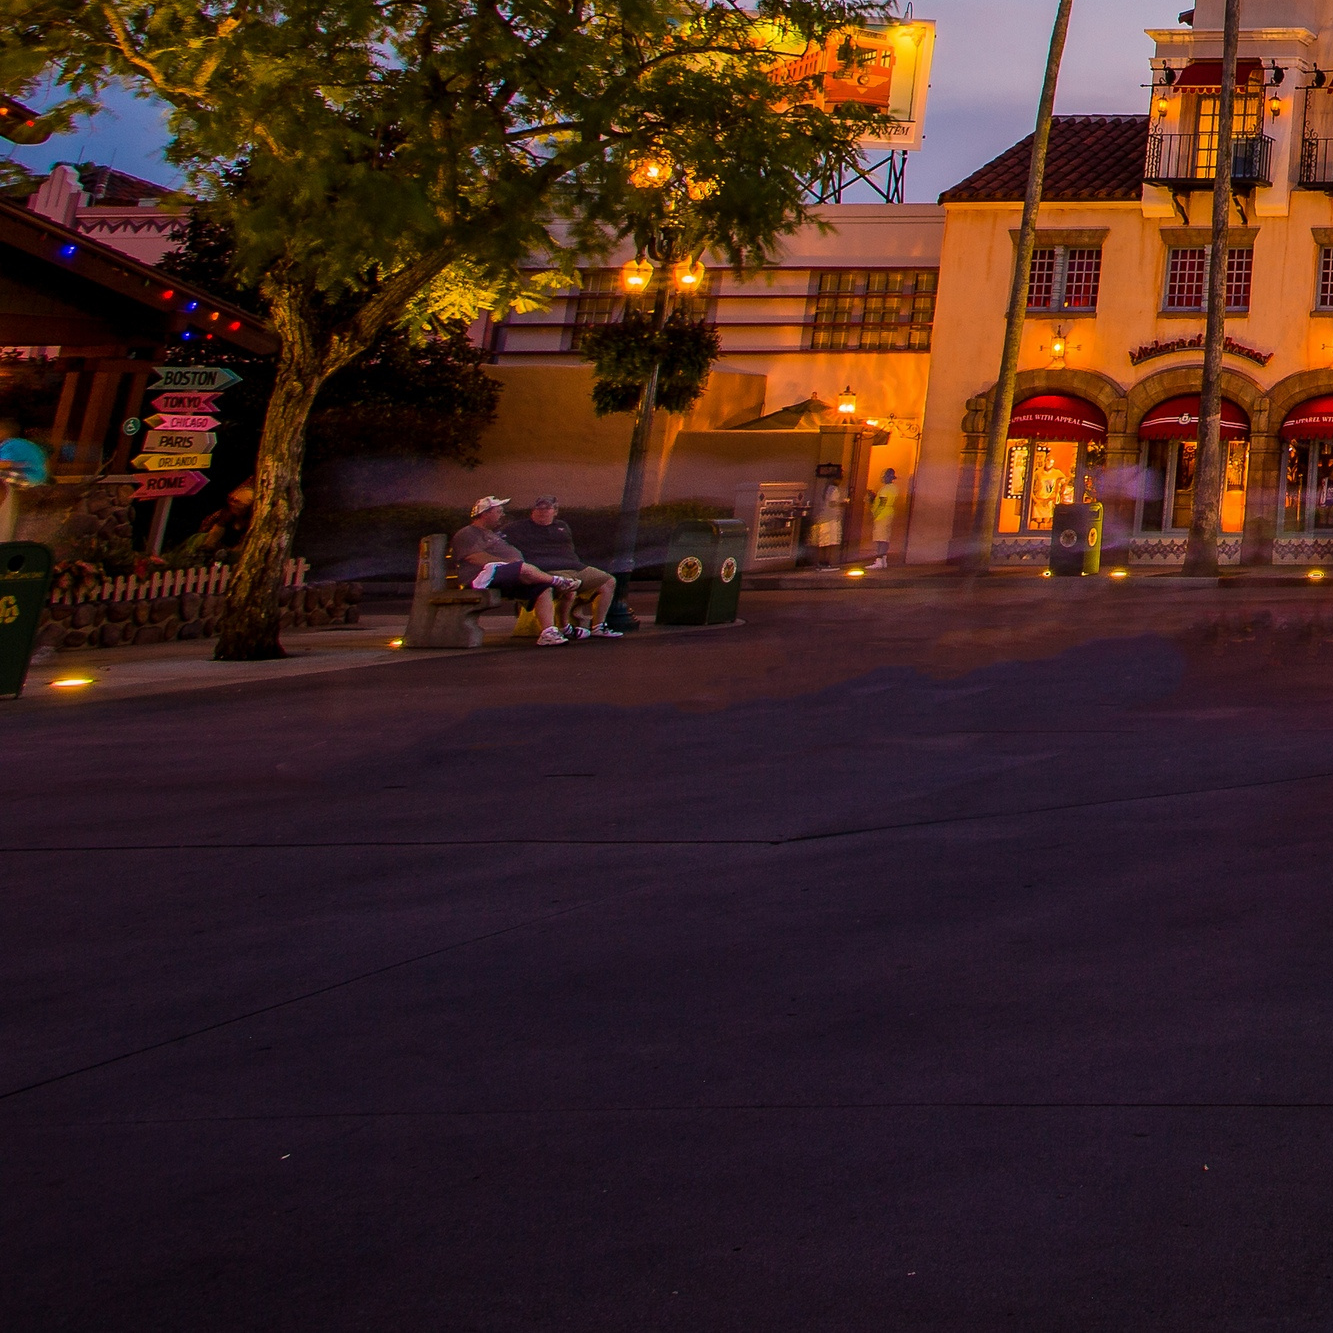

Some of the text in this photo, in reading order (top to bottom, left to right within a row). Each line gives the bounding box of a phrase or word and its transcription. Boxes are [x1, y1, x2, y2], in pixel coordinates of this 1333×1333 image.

[163, 370, 218, 386] BOSTON
[163, 396, 203, 409] TOKYO
[170, 417, 209, 429] CHICAGO
[1054, 416, 1081, 426] APPEAL
[160, 435, 194, 449] PARIS
[158, 456, 199, 469] ORLANDO
[146, 476, 188, 491] ROME
